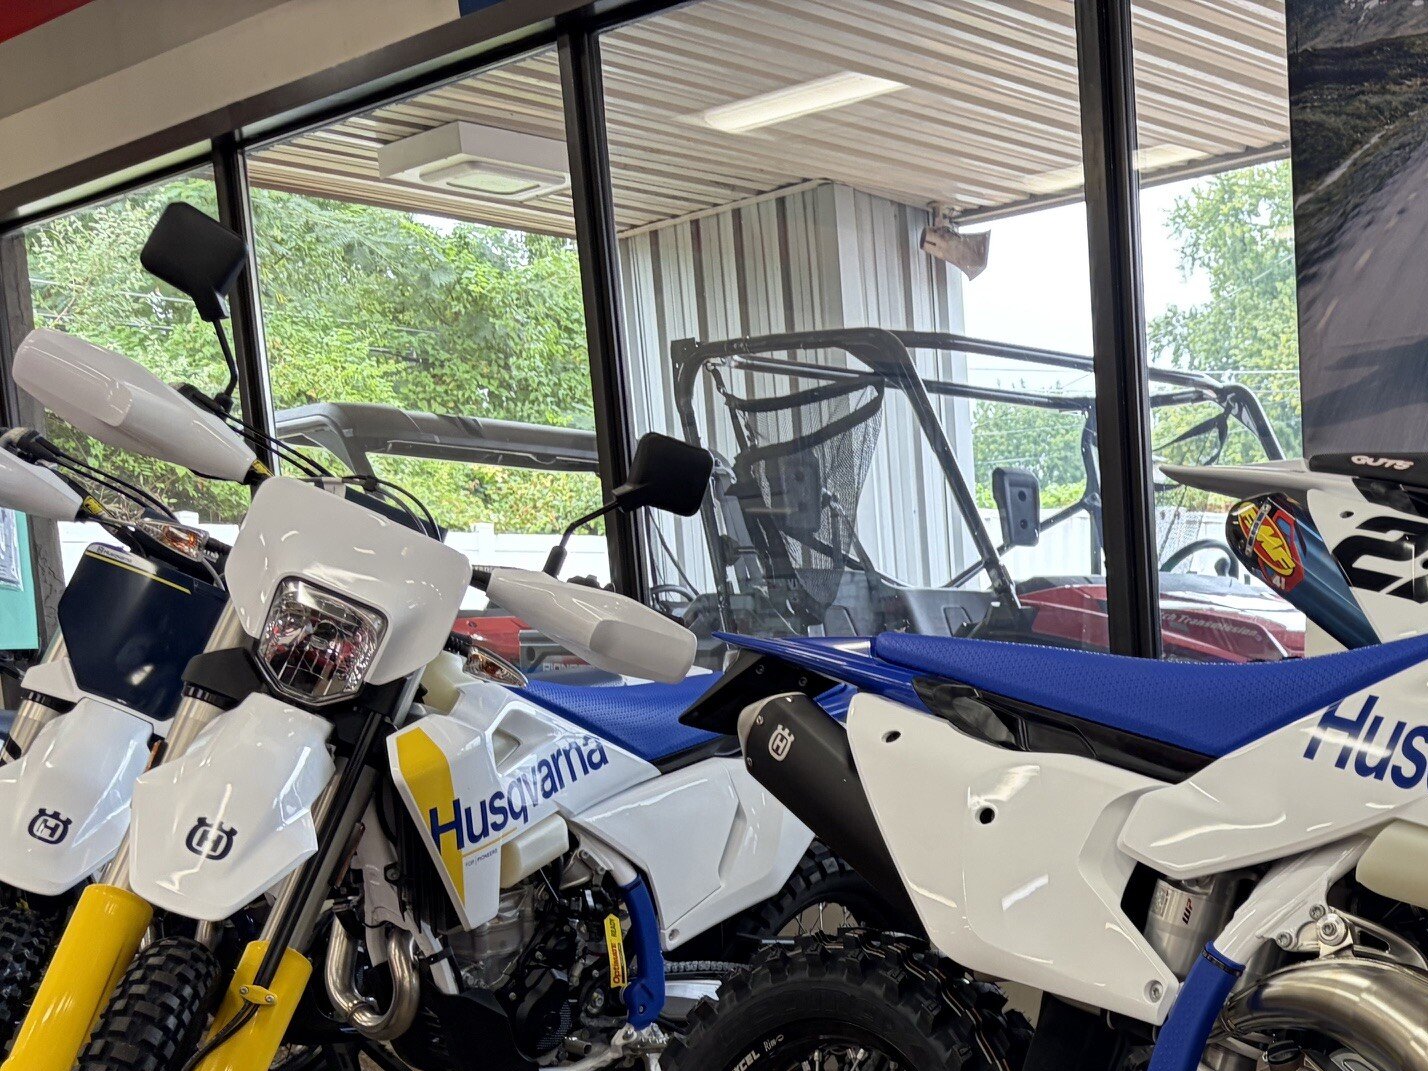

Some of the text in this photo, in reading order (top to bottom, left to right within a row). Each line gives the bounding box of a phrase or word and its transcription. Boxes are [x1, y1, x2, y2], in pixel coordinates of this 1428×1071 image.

[1351, 454, 1414, 470] GUTS
[1179, 614, 1258, 637] Transmission
[429, 736, 609, 854] Husqvarna
[1182, 898, 1193, 925] WP
